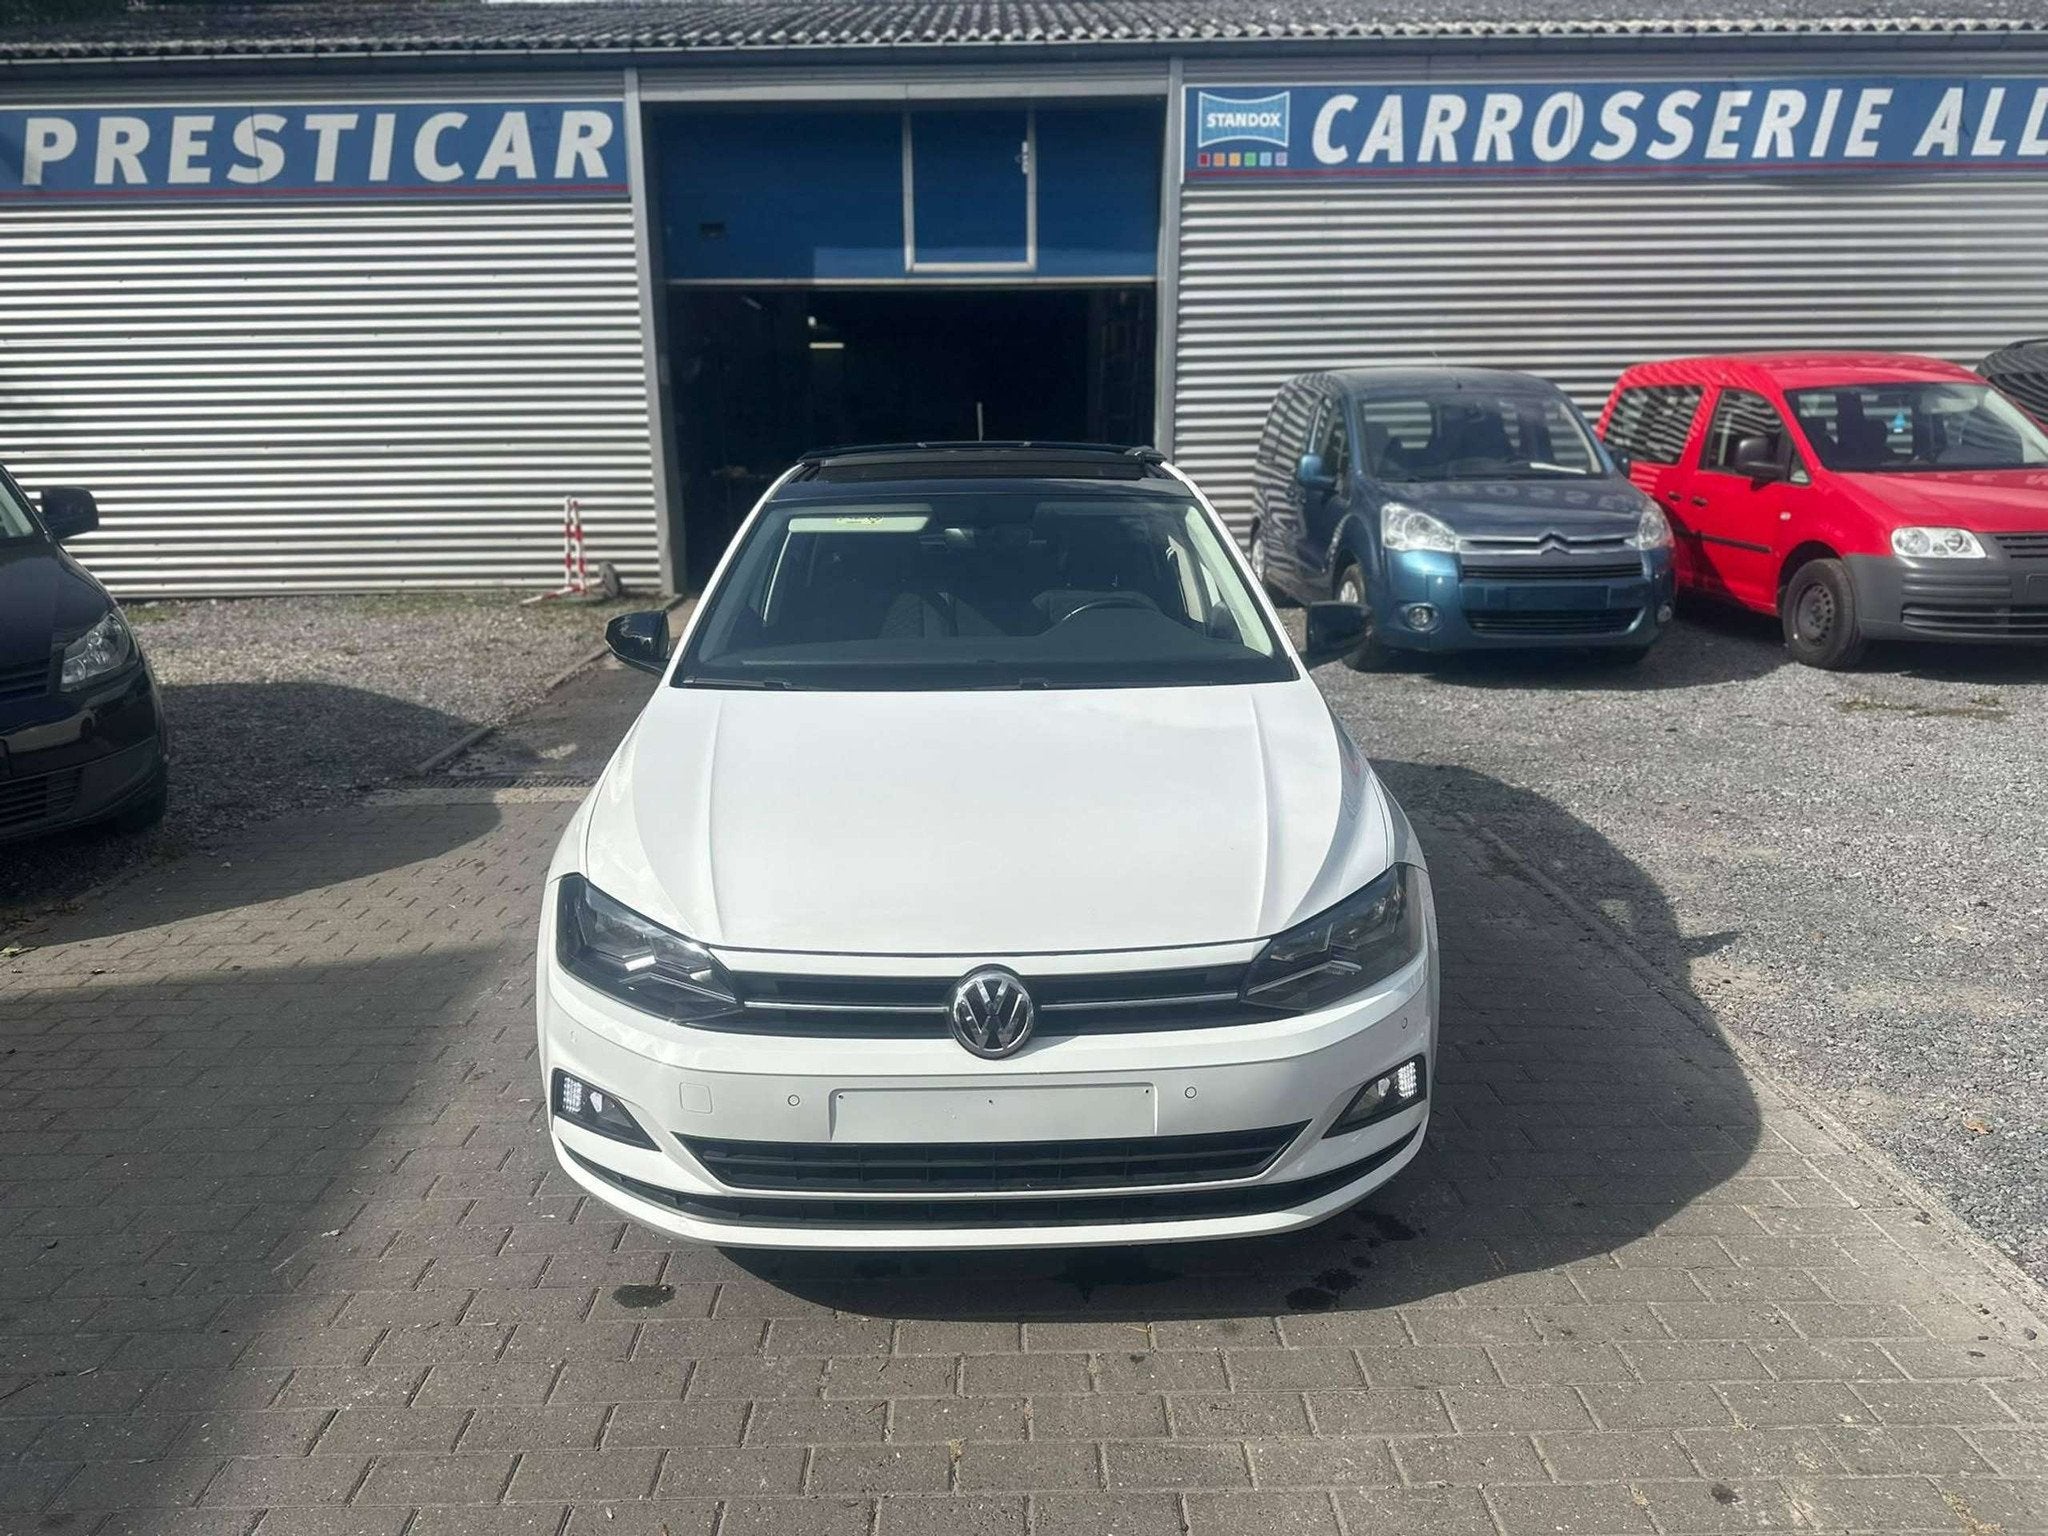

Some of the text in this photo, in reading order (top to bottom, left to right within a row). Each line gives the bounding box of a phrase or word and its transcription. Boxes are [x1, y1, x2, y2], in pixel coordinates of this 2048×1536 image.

[22, 110, 613, 186] PRESTICAR
[1206, 112, 1282, 127] STANDOX
[1312, 88, 1893, 165] CARROSSERIE
